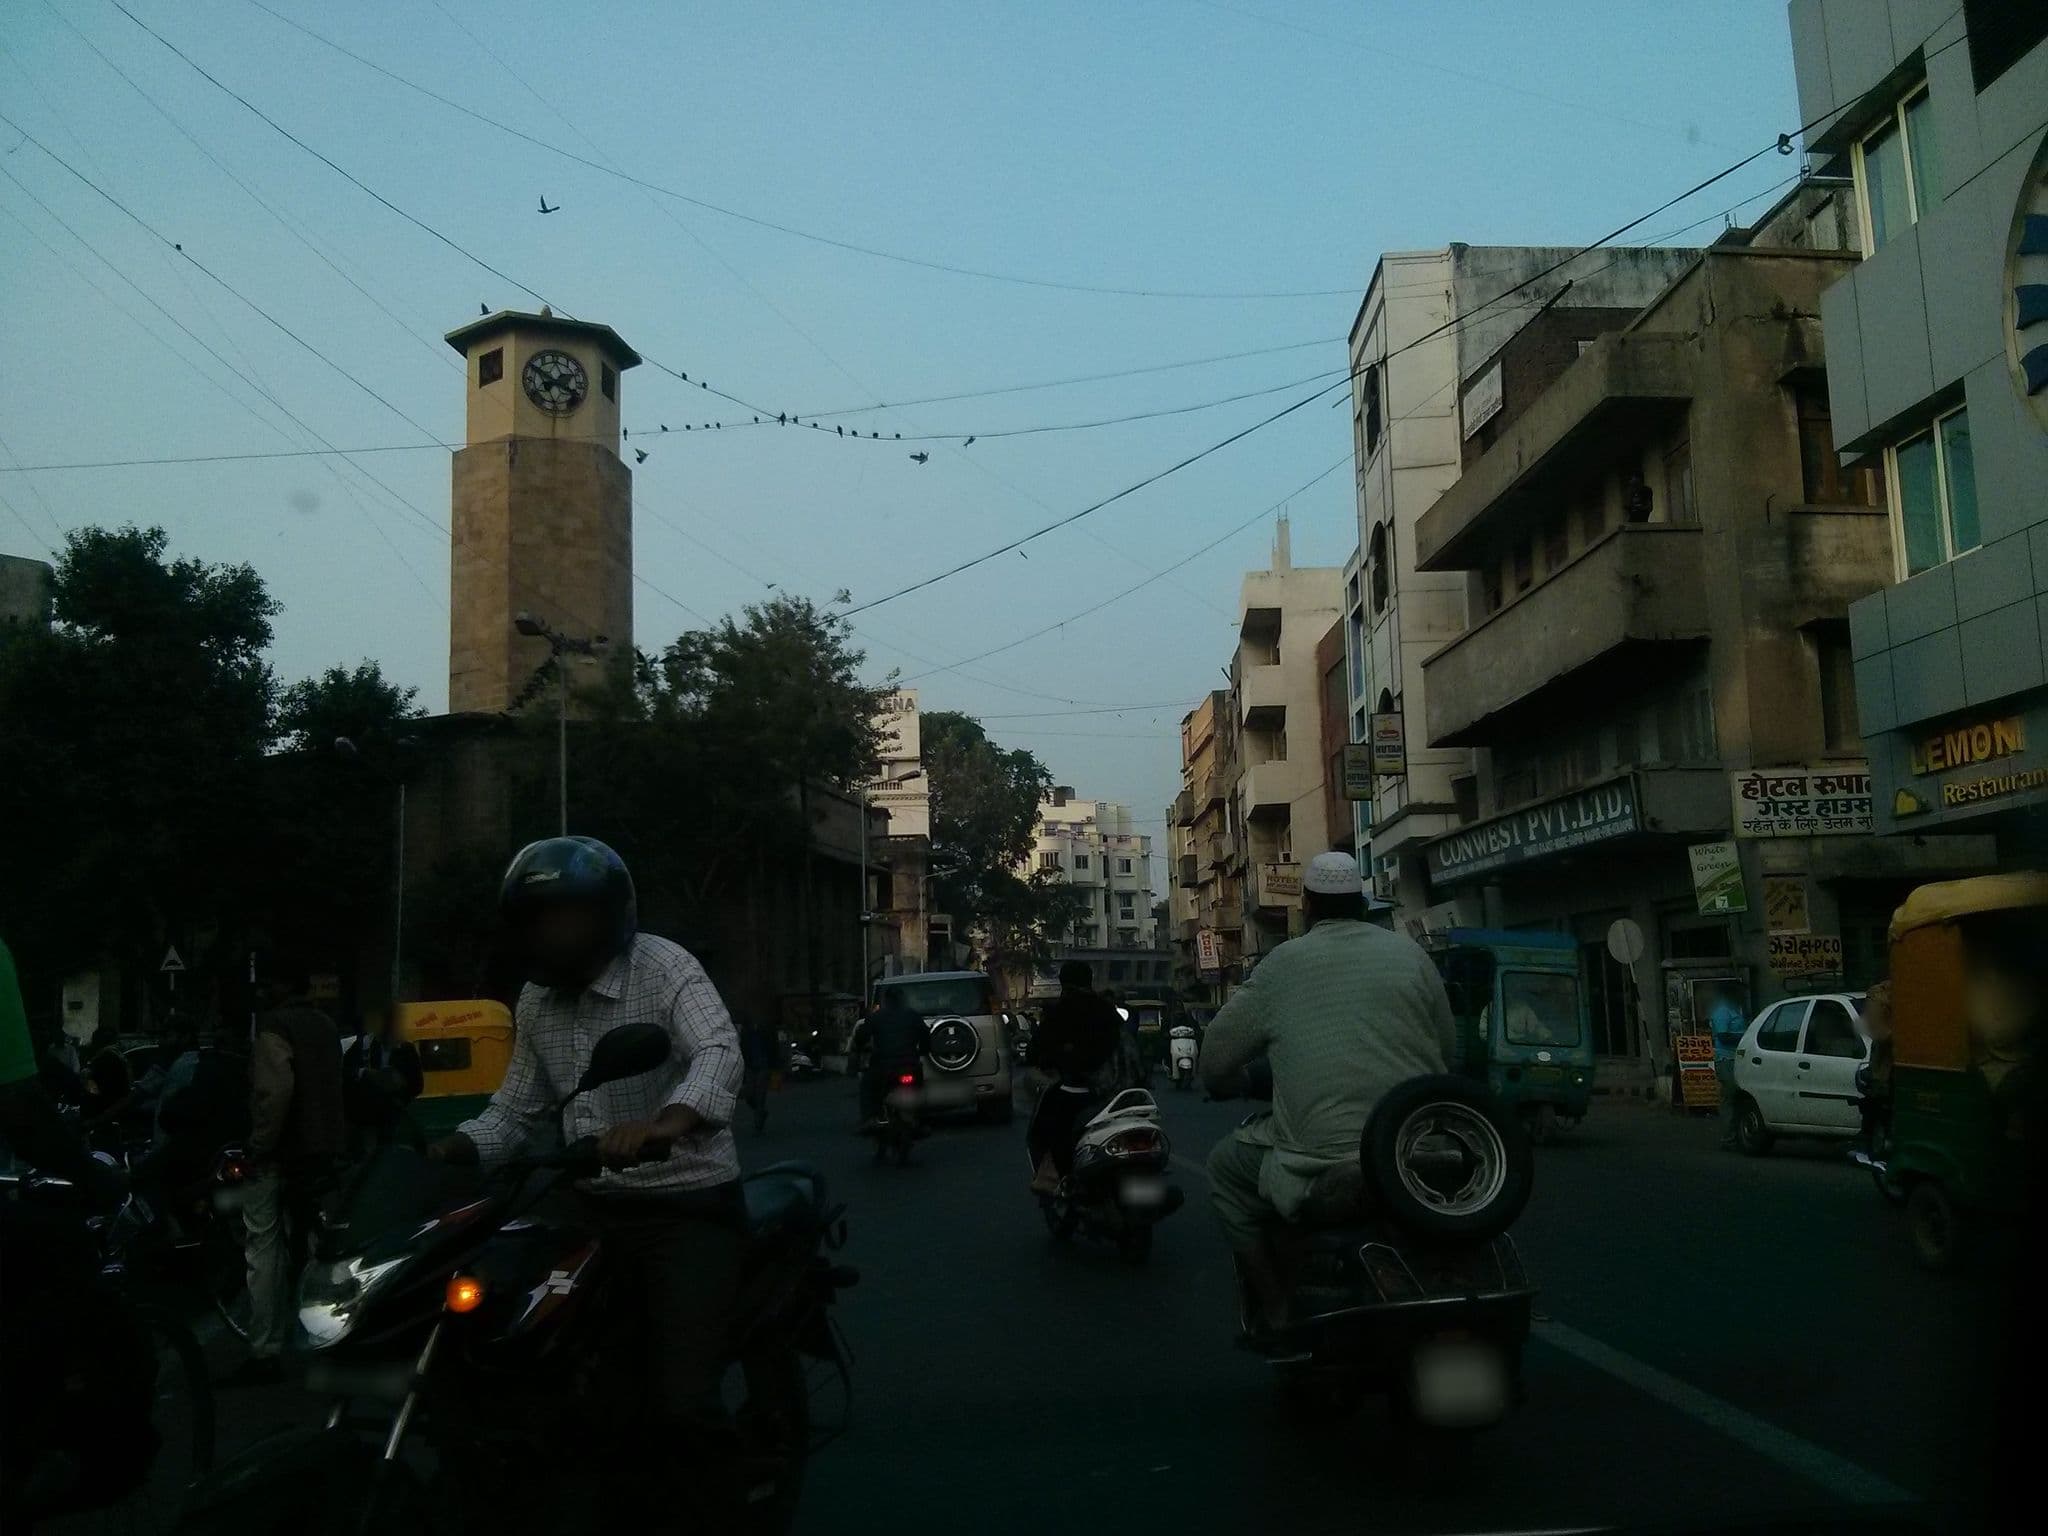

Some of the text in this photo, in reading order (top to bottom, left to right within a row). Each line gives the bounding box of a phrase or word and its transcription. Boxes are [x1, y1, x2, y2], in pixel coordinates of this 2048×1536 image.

[1911, 716, 2024, 776] LEMON
[1738, 773, 1808, 800] होटल
[1943, 768, 2048, 806] Restauran
[1757, 796, 1811, 817] गेस्ट
[1438, 818, 1521, 866] CONWEST
[1696, 862, 1732, 872] Green
